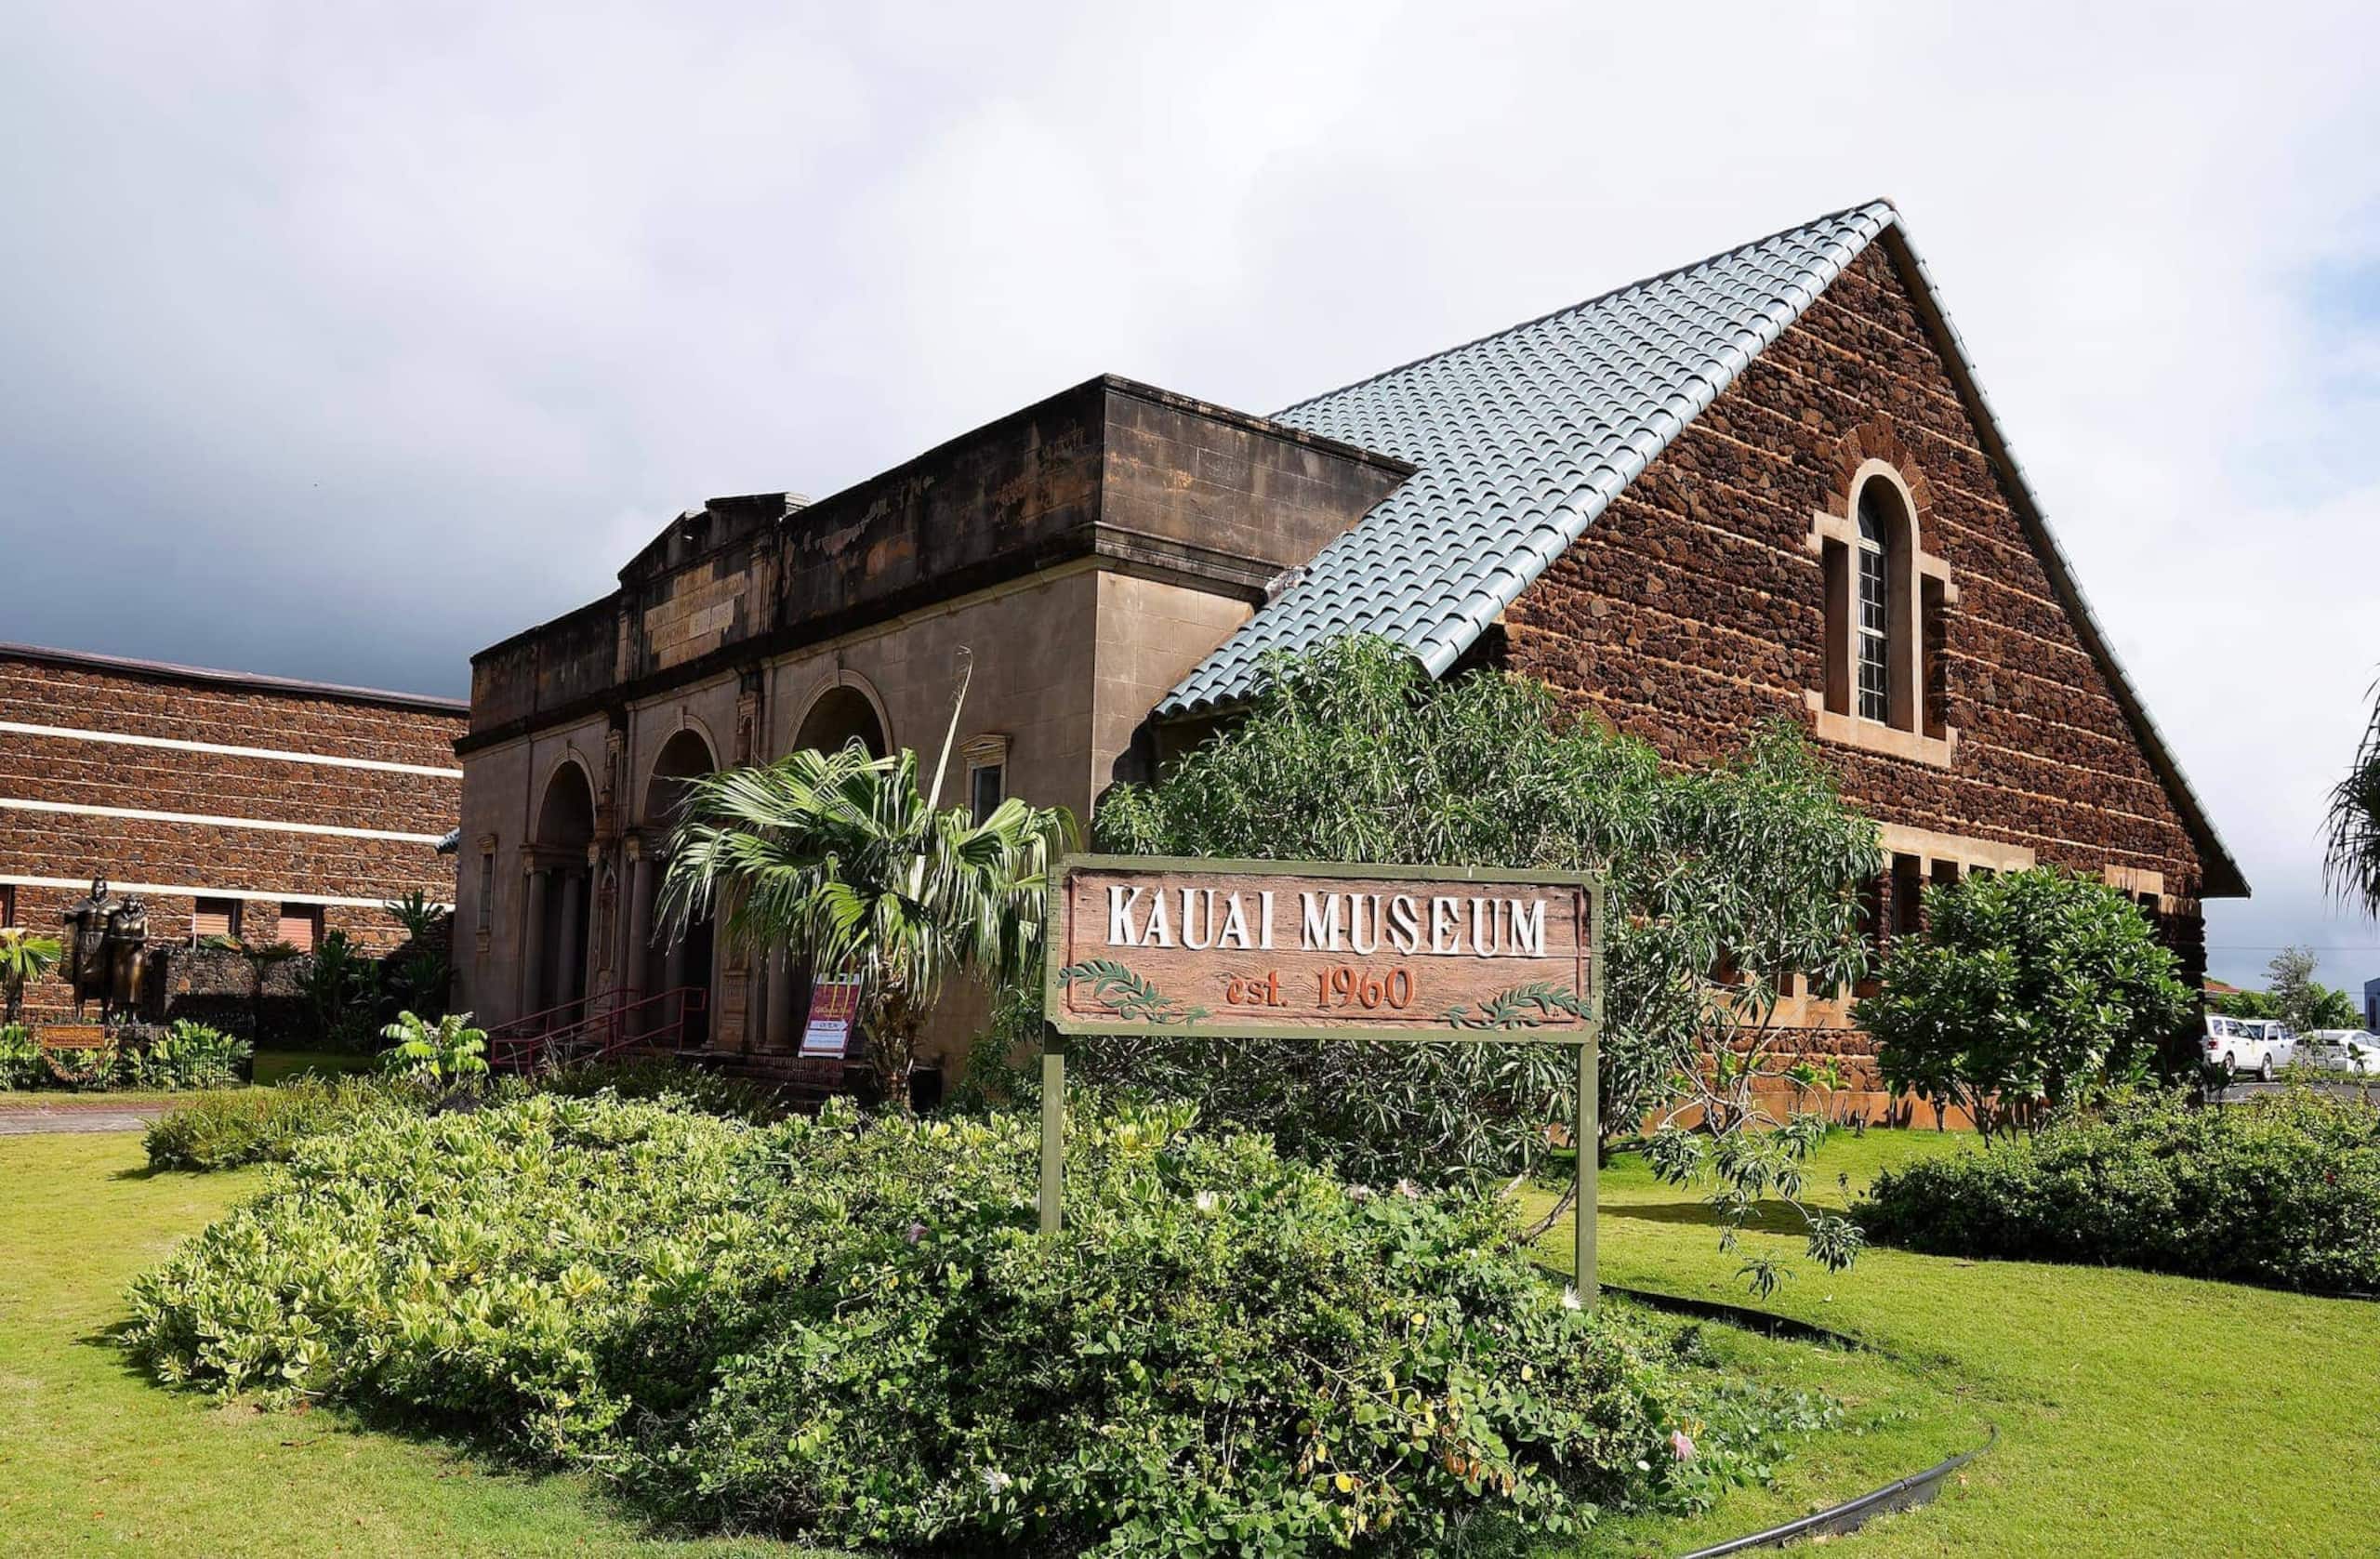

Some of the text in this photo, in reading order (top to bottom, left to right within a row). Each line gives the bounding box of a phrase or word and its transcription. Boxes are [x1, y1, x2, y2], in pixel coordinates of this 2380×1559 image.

[1105, 885, 1547, 958] KAUAI MUSEUM
[1226, 966, 1415, 1009] est. 1960
